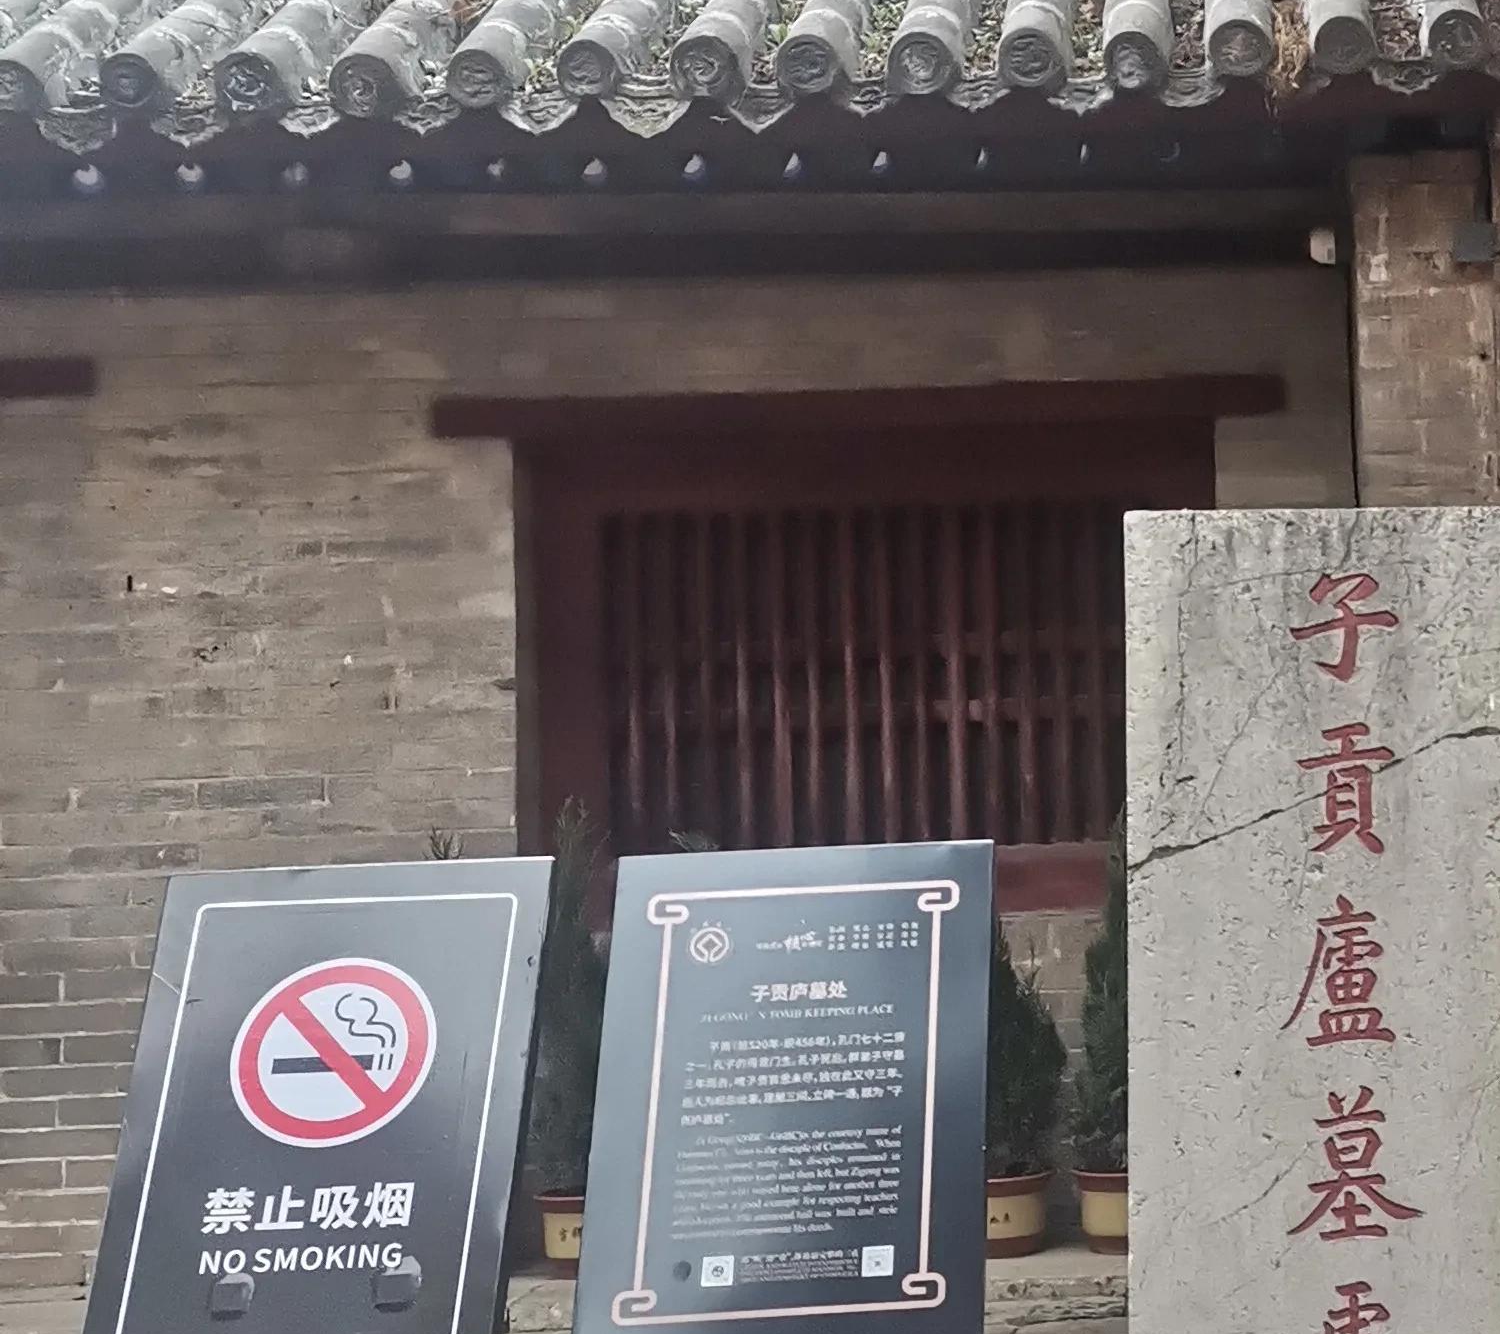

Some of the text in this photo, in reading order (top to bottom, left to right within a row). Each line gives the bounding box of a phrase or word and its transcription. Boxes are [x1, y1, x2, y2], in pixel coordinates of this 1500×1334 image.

[750, 979, 848, 1004] 子贡庐墓处
[804, 1006, 855, 1018] KEEPING
[857, 1003, 895, 1015] PLACE
[200, 1181, 415, 1235] 禁止吸烟
[198, 1241, 404, 1276] NO SMOKING
